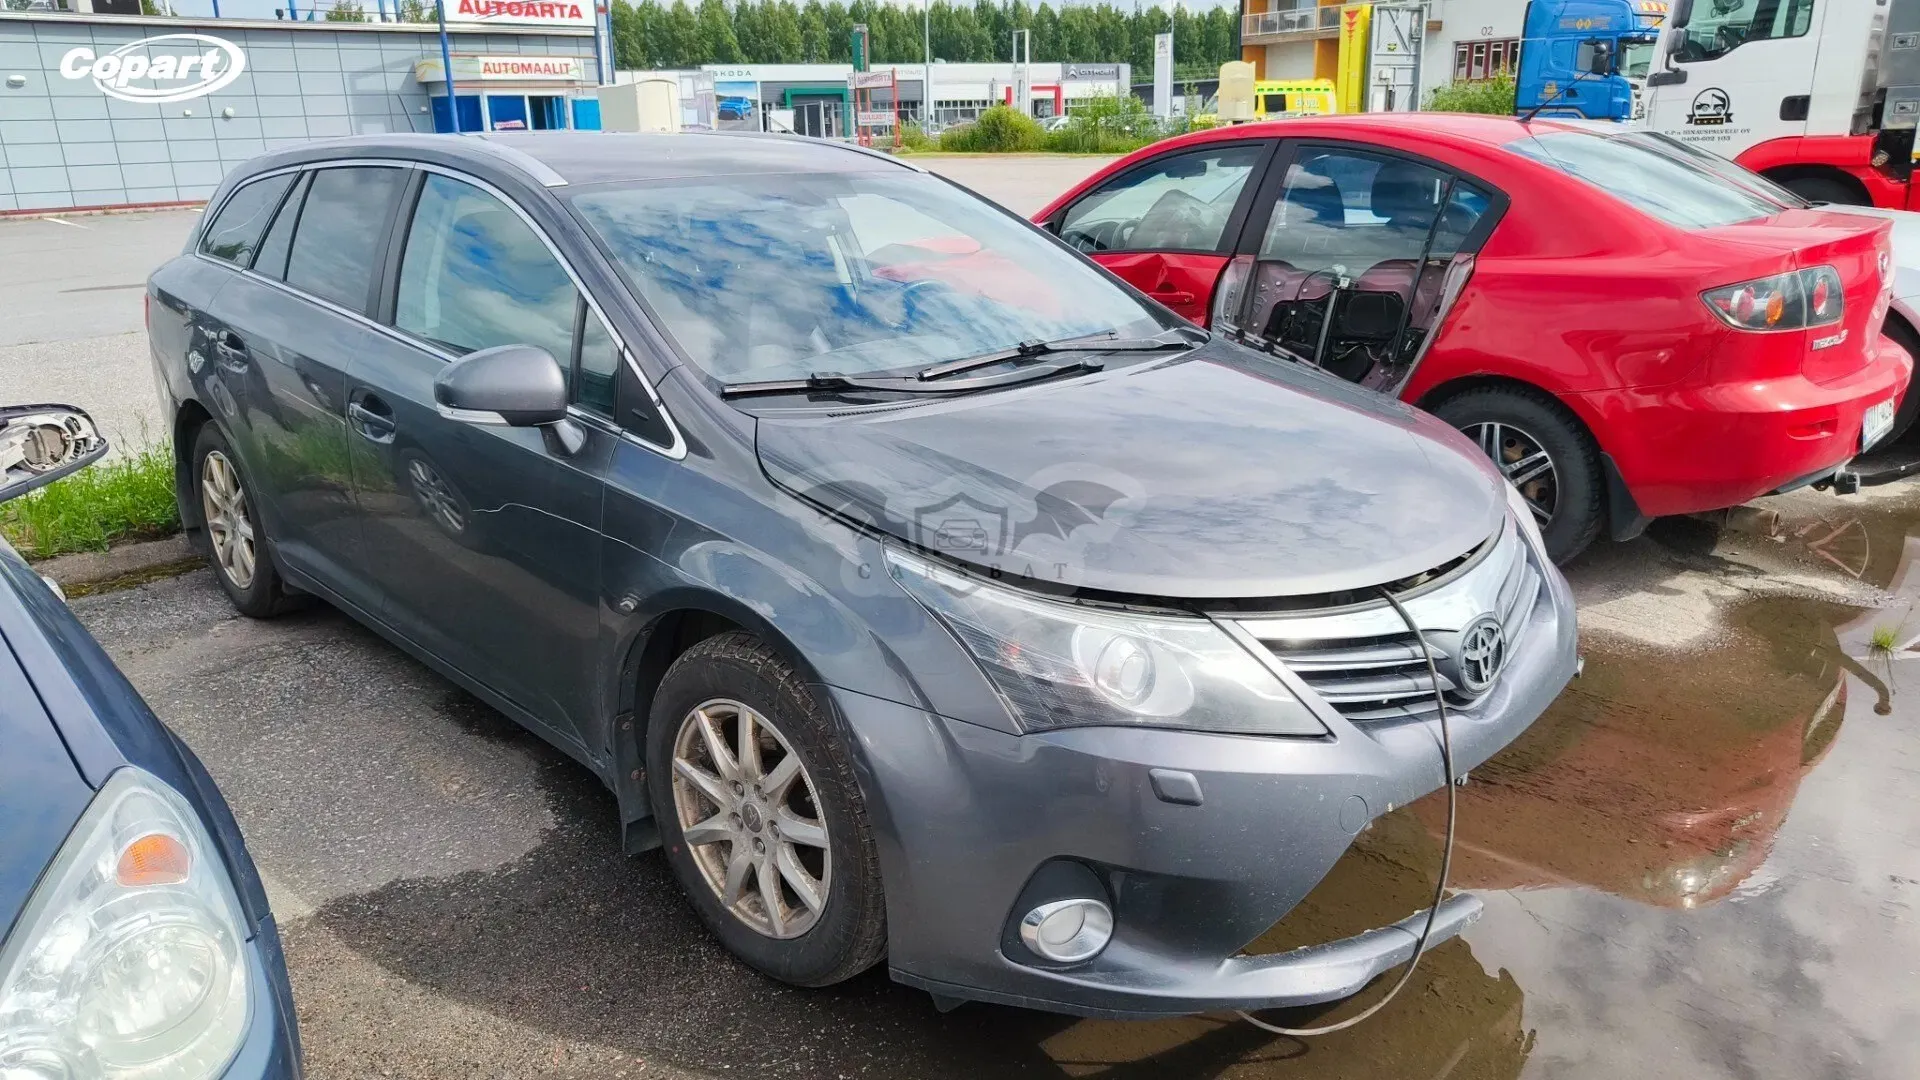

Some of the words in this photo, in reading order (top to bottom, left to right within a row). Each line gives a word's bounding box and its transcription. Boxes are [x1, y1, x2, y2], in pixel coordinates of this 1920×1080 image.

[458, 0, 583, 19] AUTOARTA
[1481, 25, 1494, 37] 02
[482, 61, 571, 75] AUTOMAALIT
